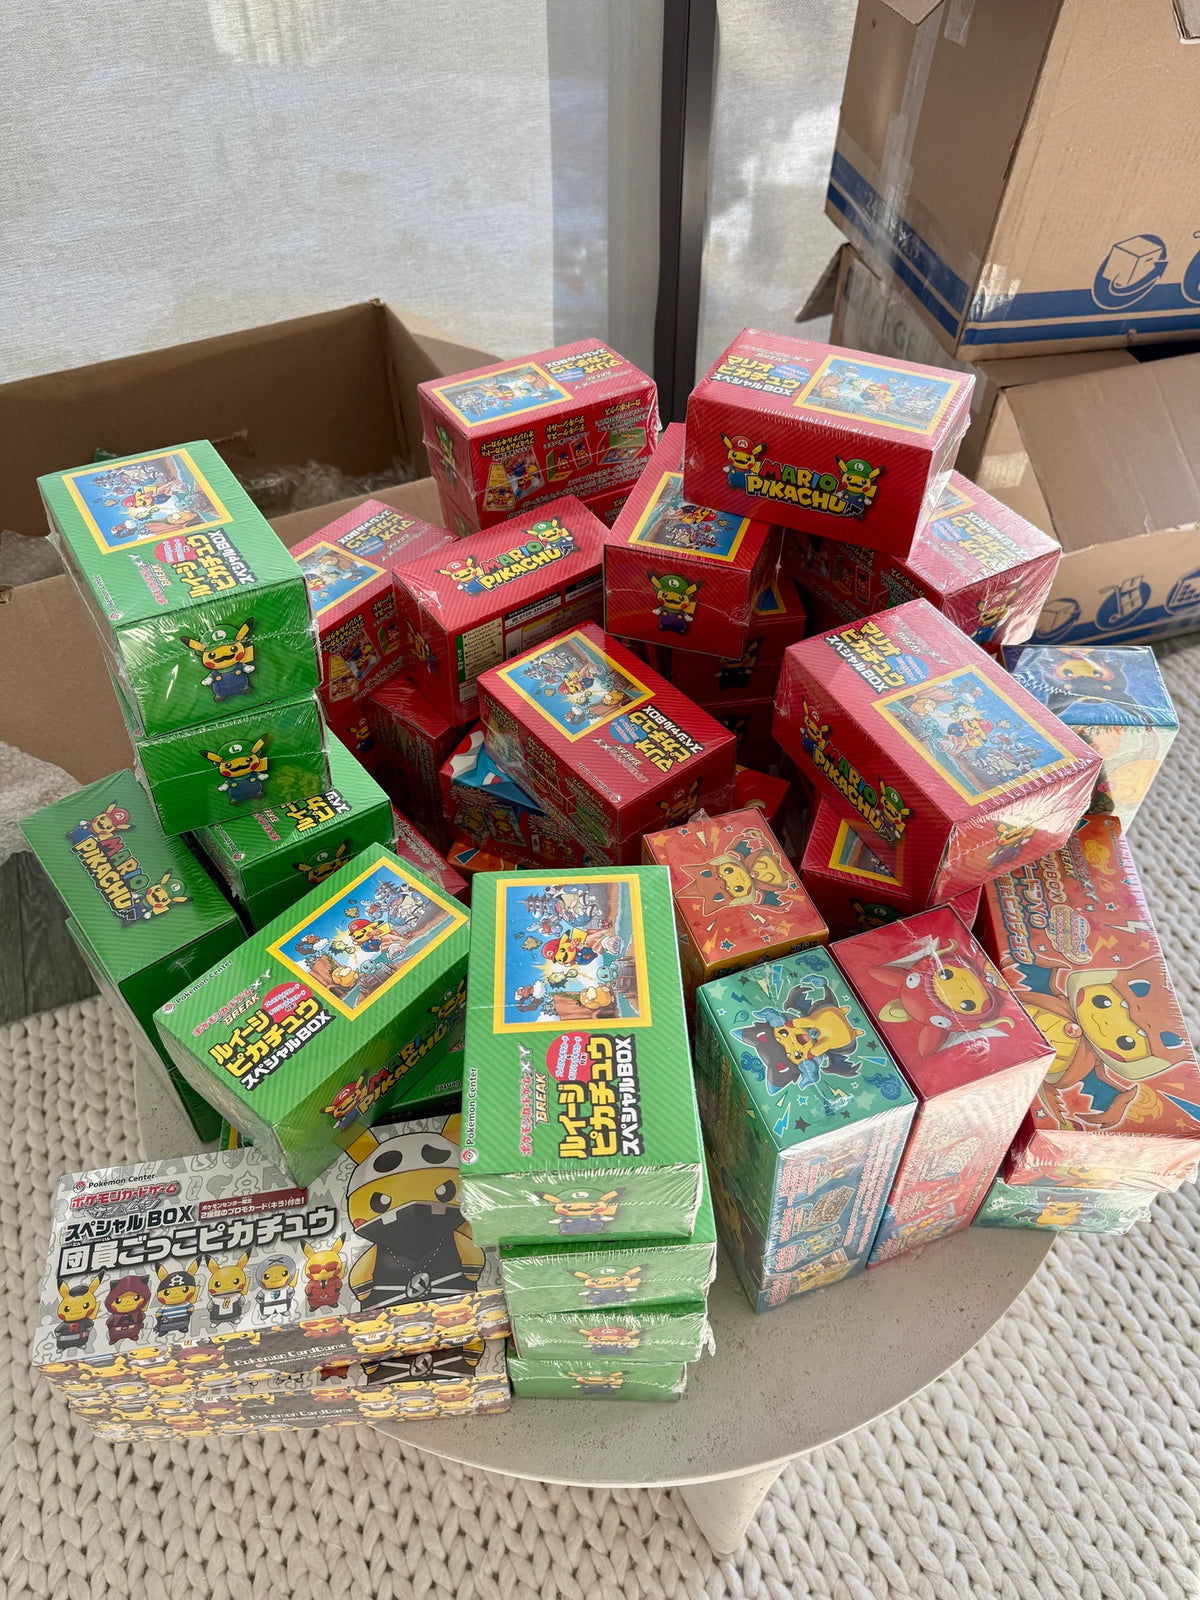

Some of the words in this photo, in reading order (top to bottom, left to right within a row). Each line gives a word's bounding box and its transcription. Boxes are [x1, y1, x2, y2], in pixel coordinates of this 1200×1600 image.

[583, 359, 624, 375] マリオ
[710, 372, 794, 397] スペシャルBOX
[717, 363, 801, 389] ピカチュウ
[727, 355, 775, 373] マリオ
[746, 474, 848, 513] PIKACHU
[759, 459, 838, 492] MARIO
[337, 508, 393, 546] スペシャルBOX
[345, 513, 404, 550] ピカチュウ
[171, 560, 215, 599] ルイージ
[186, 533, 238, 592] ピカチュウ
[207, 528, 258, 586] スペシャルBOX
[478, 547, 562, 590] PIKACHU
[480, 541, 544, 574] MARIO
[839, 628, 907, 687] ピカチュウ
[859, 620, 902, 658] マリオ
[825, 634, 890, 694] スペシャルBOX
[627, 711, 692, 764] ピカチュウ
[641, 704, 704, 754] スペシャルBOX
[634, 737, 675, 773] マリオ
[822, 741, 878, 807] MARIO
[813, 746, 883, 833] PIKACHU
[72, 836, 135, 911] PIKACHU
[100, 836, 151, 893] MARIO
[174, 976, 210, 1005] Pokémon
[208, 959, 234, 980] Center
[222, 992, 262, 1028] BREAK
[209, 1009, 272, 1065] ルイージ
[225, 997, 321, 1078] ピカチュウ
[240, 1010, 333, 1090] スペシャルBOX
[367, 1020, 438, 1093] MARIO
[357, 1025, 449, 1116] PIKACHU
[468, 1067, 479, 1100] Center
[534, 1072, 550, 1125] BREAK
[586, 1036, 618, 1157] ピカチュウ
[615, 1036, 641, 1157] スペシャルBOX
[465, 1101, 479, 1146] Pokémon
[558, 1083, 588, 1160] ルイージ
[71, 1182, 179, 1209] ポケモンカードゲーム
[88, 1177, 126, 1189] Pokémon
[127, 1173, 156, 1183] Center
[58, 1207, 337, 1277] 団員ごっこピカチュウ
[233, 1352, 286, 1368] Pokémon
